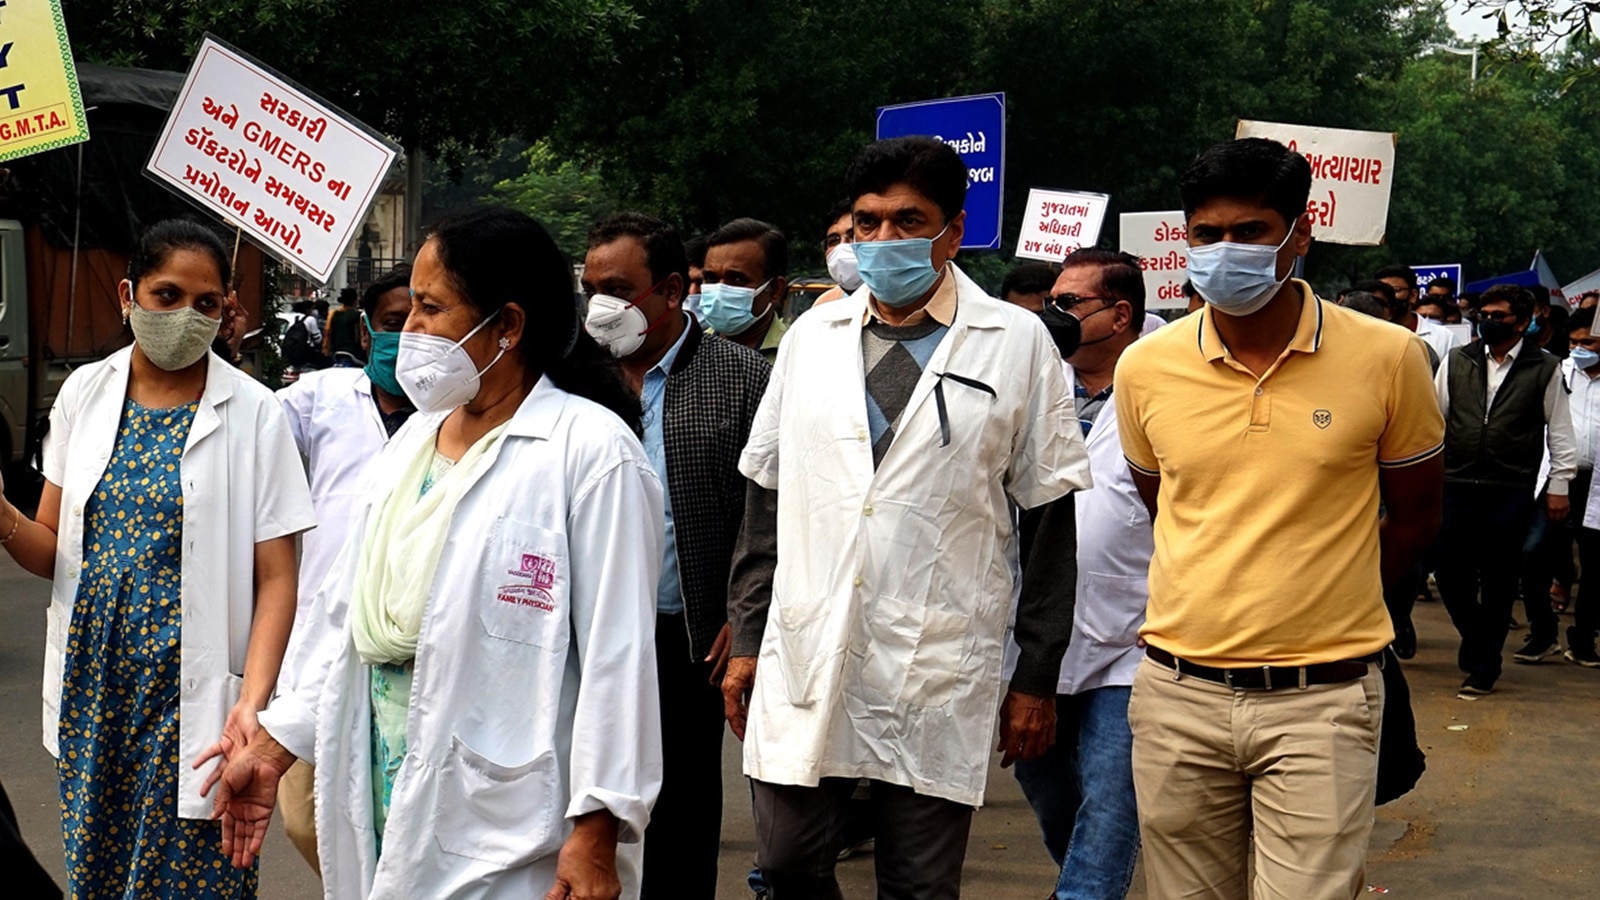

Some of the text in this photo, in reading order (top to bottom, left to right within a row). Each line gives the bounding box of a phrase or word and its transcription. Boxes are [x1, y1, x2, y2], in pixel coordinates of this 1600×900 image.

[0, 111, 66, 141] G.M.T.A.
[259, 91, 328, 143] સરકારી
[202, 96, 352, 201] અને GMERS ના
[183, 164, 303, 255] પ્રમોશન આપો.
[265, 176, 335, 233] સમયસર
[1041, 201, 1090, 218] ગુજરાતમાં
[1039, 218, 1082, 237] અધિકારી
[497, 593, 521, 604] FAMILY
[522, 598, 554, 612] PHYSICIAN
